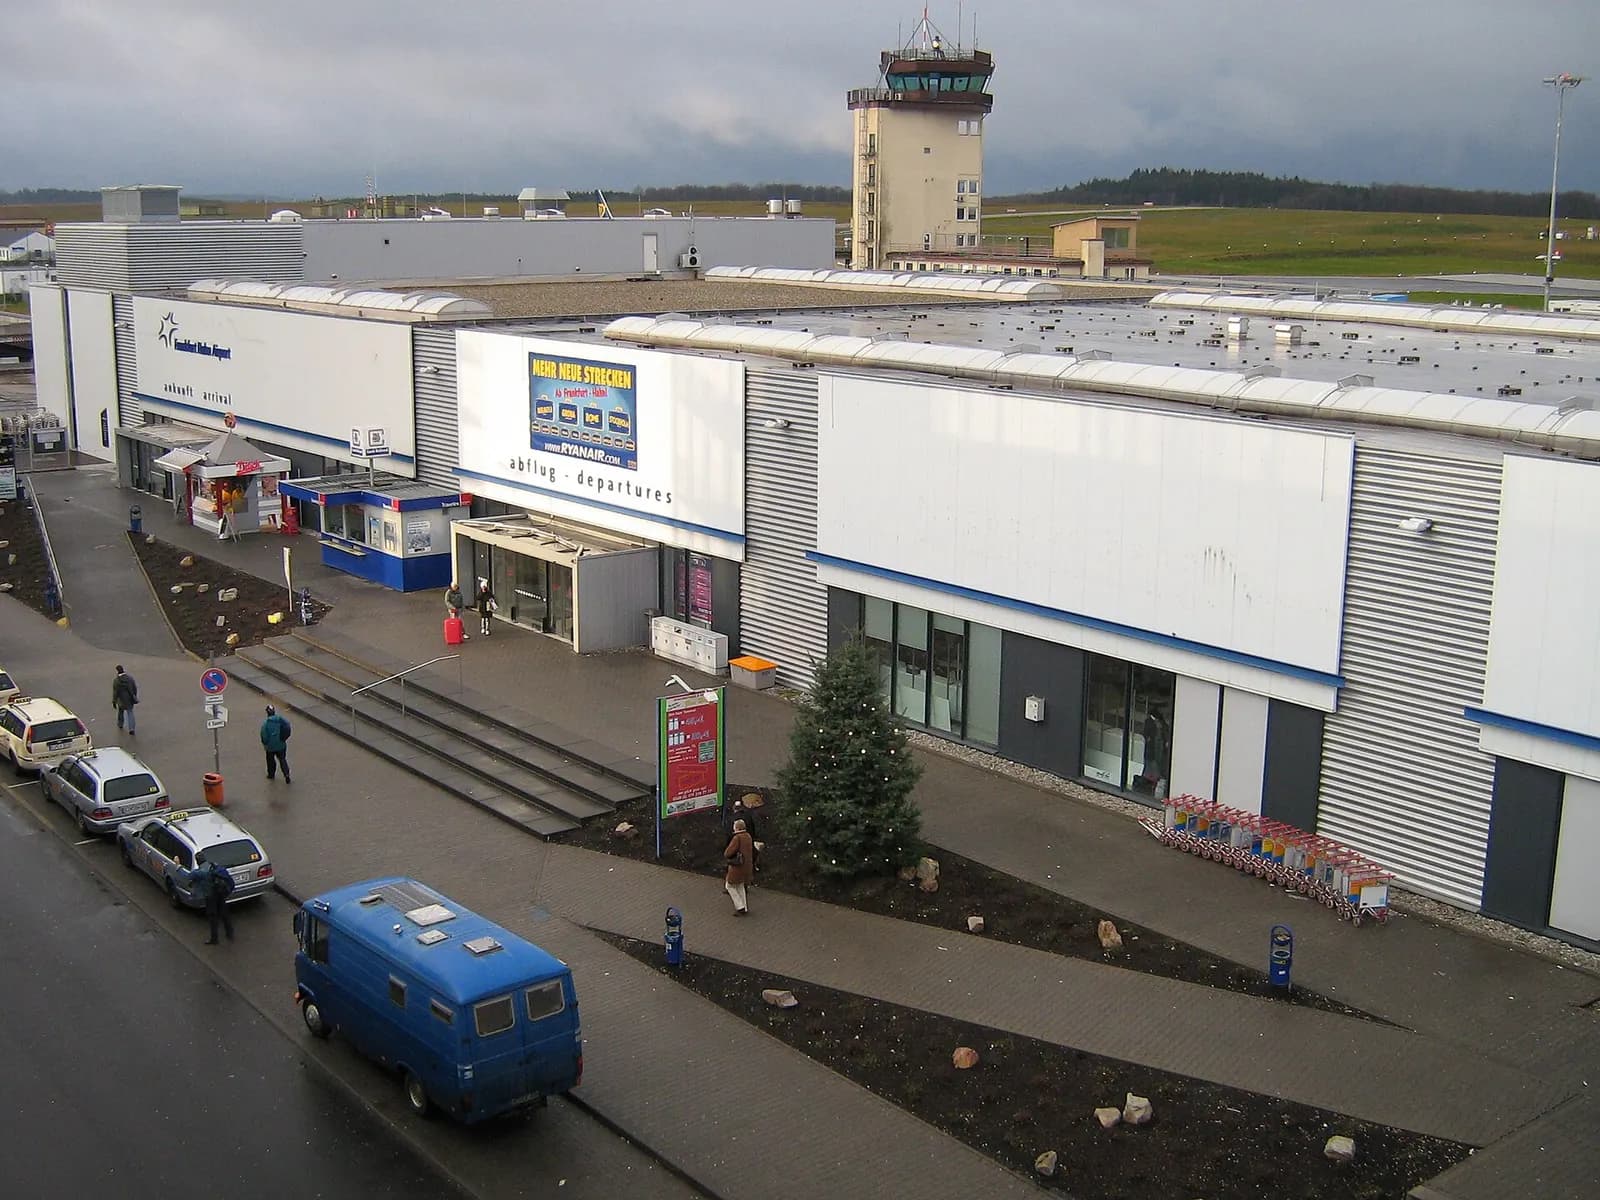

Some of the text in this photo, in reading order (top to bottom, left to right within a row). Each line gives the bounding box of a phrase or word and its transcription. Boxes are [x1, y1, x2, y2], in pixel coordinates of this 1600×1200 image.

[533, 359, 632, 389] MEHR NEUE STRECKEN
[203, 391, 232, 406] arrival
[510, 457, 556, 482] abflug
[578, 470, 672, 503] departures
